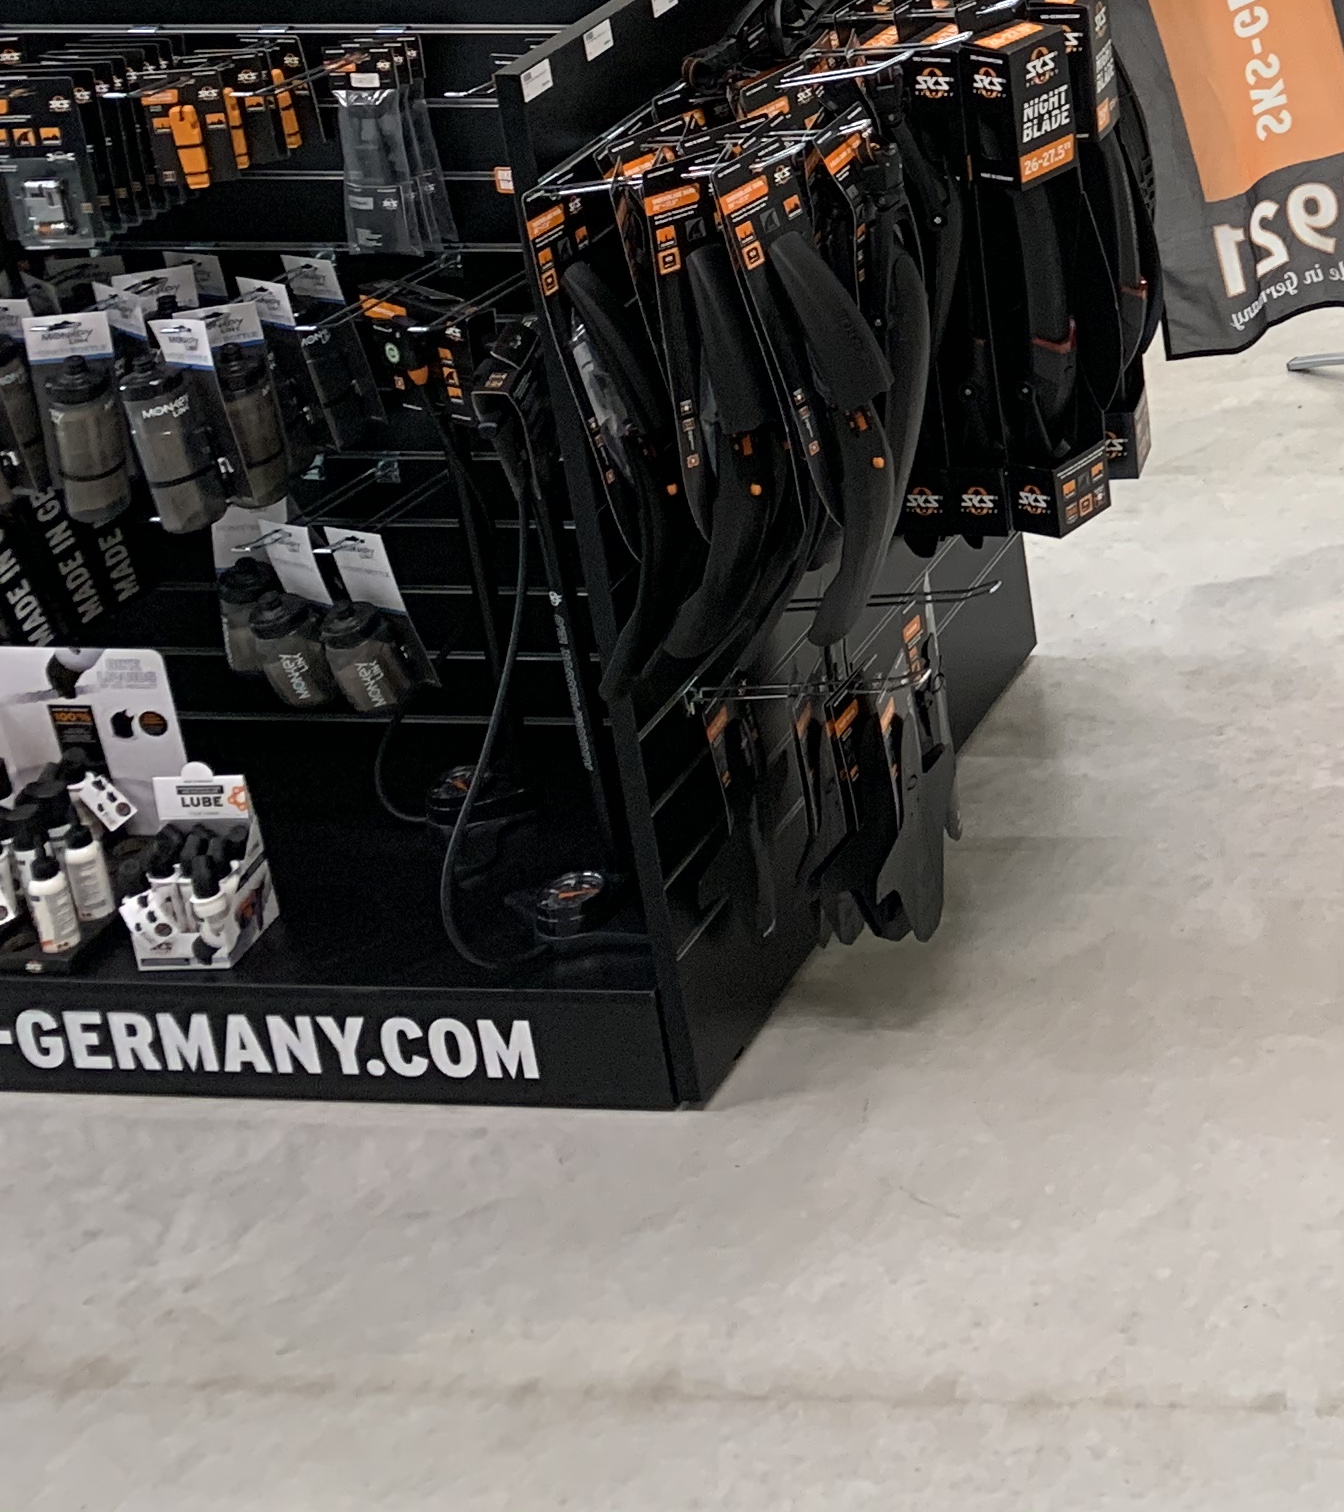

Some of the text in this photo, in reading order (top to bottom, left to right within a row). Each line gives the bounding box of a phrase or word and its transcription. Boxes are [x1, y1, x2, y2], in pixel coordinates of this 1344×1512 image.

[1021, 104, 1072, 144] BLADE
[1022, 84, 1070, 123] NIGHT
[45, 520, 104, 624] MADE IN
[98, 527, 140, 603] MADE
[5, 578, 54, 646] MADE
[181, 795, 224, 809] LUBE
